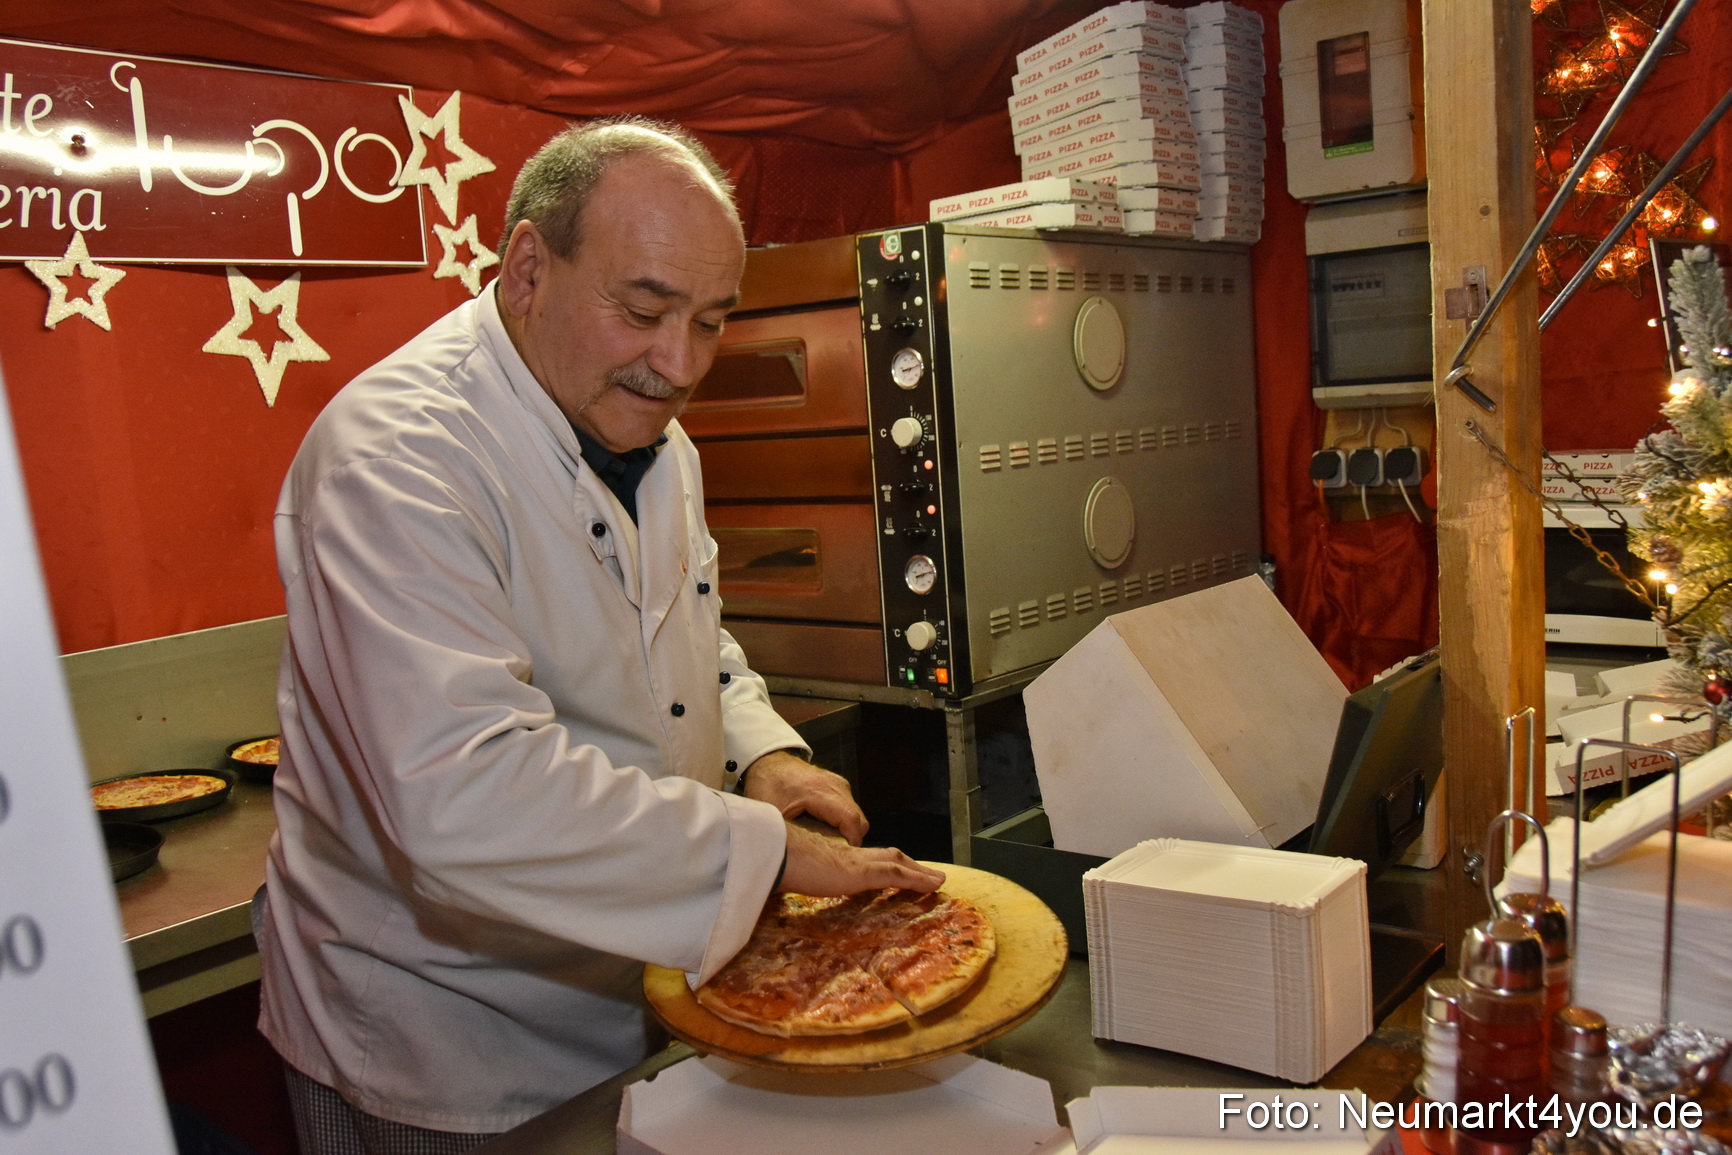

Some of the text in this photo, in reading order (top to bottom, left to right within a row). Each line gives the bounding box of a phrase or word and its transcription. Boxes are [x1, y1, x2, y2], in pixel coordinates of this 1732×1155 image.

[1024, 15, 1108, 65] PIZZA PIZZA PIZZA
[1019, 42, 1104, 87] PIZZA PIZZA PIZZA
[1015, 69, 1099, 109] PIZZA PIZZA PIZZA
[1018, 89, 1101, 128] PIZZA PIZZA PIZZA
[1142, 106, 1159, 116] PIZZA
[1020, 113, 1102, 148] PIZZA PIZZA PIZZA
[1154, 127, 1171, 137] PIZZA
[1028, 131, 1115, 163] PIZZA PIZZA PIZZA
[1154, 149, 1196, 161] PIZZA PIZZA
[1058, 161, 1082, 174] PIZZA
[1089, 152, 1114, 165] PIZZA
[1158, 172, 1174, 181] PIZZA
[1071, 187, 1115, 200] PIZZA PIZZA
[937, 189, 1028, 215] PIZZA PIZZA PIZZA
[1006, 214, 1033, 226] PIZZA
[1076, 213, 1121, 225] PIZZA PIZZA
[917, 319, 924, 328] 2
[1583, 462, 1614, 470] PIZZA
[928, 483, 934, 492] 2
[931, 528, 937, 537] 2
